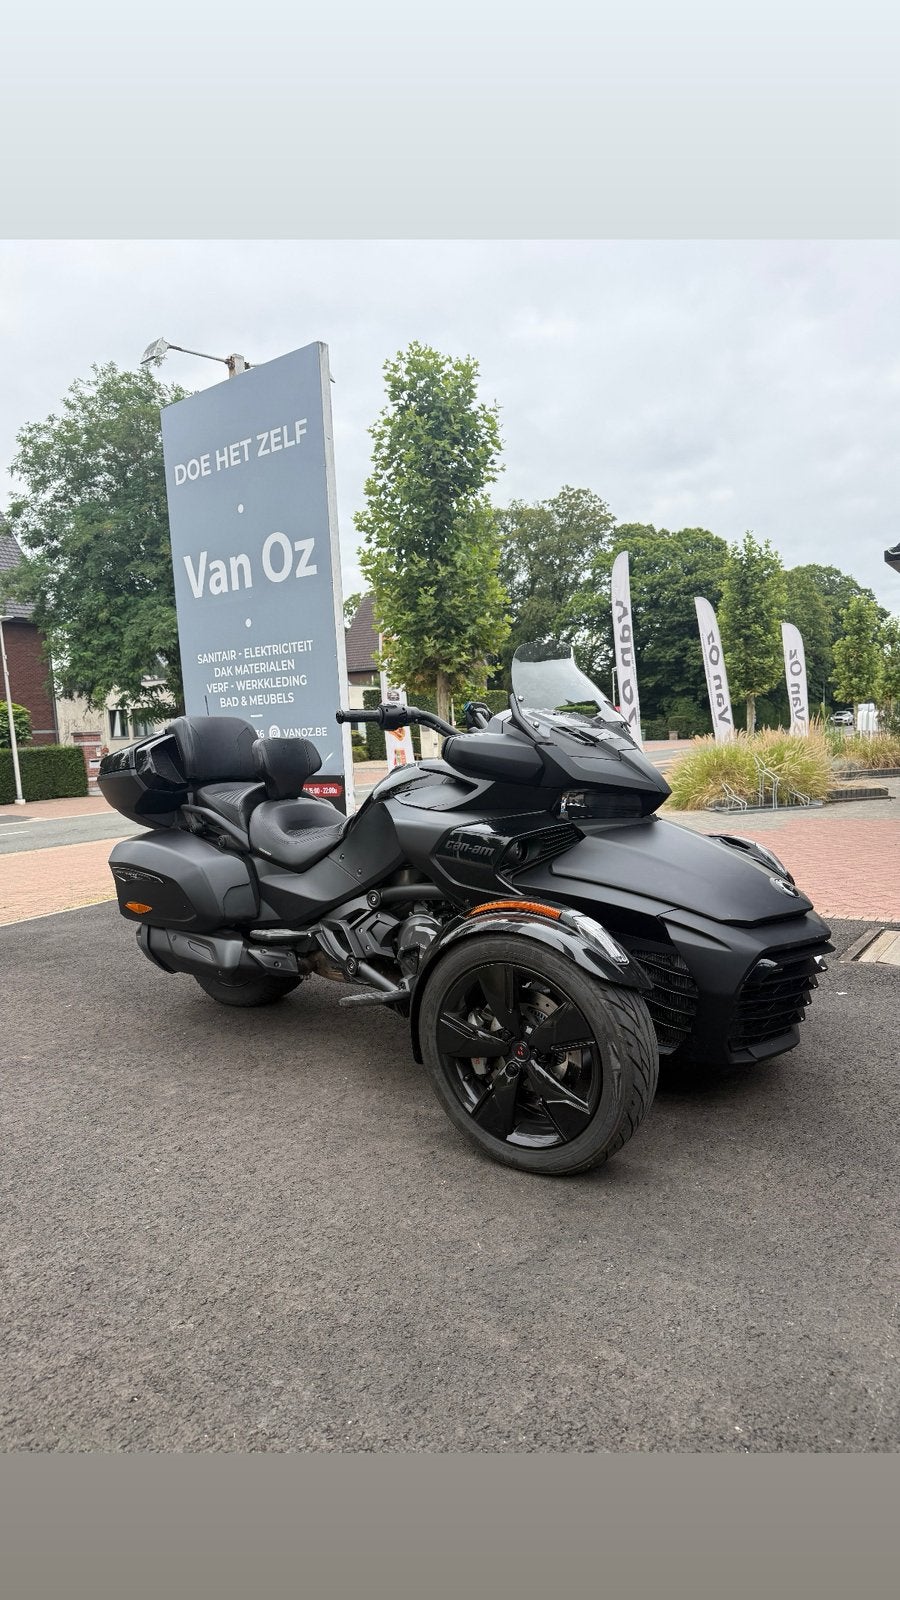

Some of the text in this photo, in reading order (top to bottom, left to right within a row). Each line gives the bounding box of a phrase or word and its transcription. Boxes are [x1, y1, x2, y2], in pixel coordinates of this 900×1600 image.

[174, 418, 308, 486] DOE HET ZELF
[183, 531, 318, 599] Van Oz
[197, 649, 237, 664] SANITAIR
[244, 640, 313, 659] ELEKTRICITEIT
[214, 659, 296, 678] DAK MATERIALEN
[206, 682, 229, 694] VERF
[235, 674, 308, 691] WERKKLEDING
[220, 692, 295, 708] BAD & MEUBELS
[283, 727, 328, 738] VANOZ.BE
[444, 840, 495, 857] can-am
